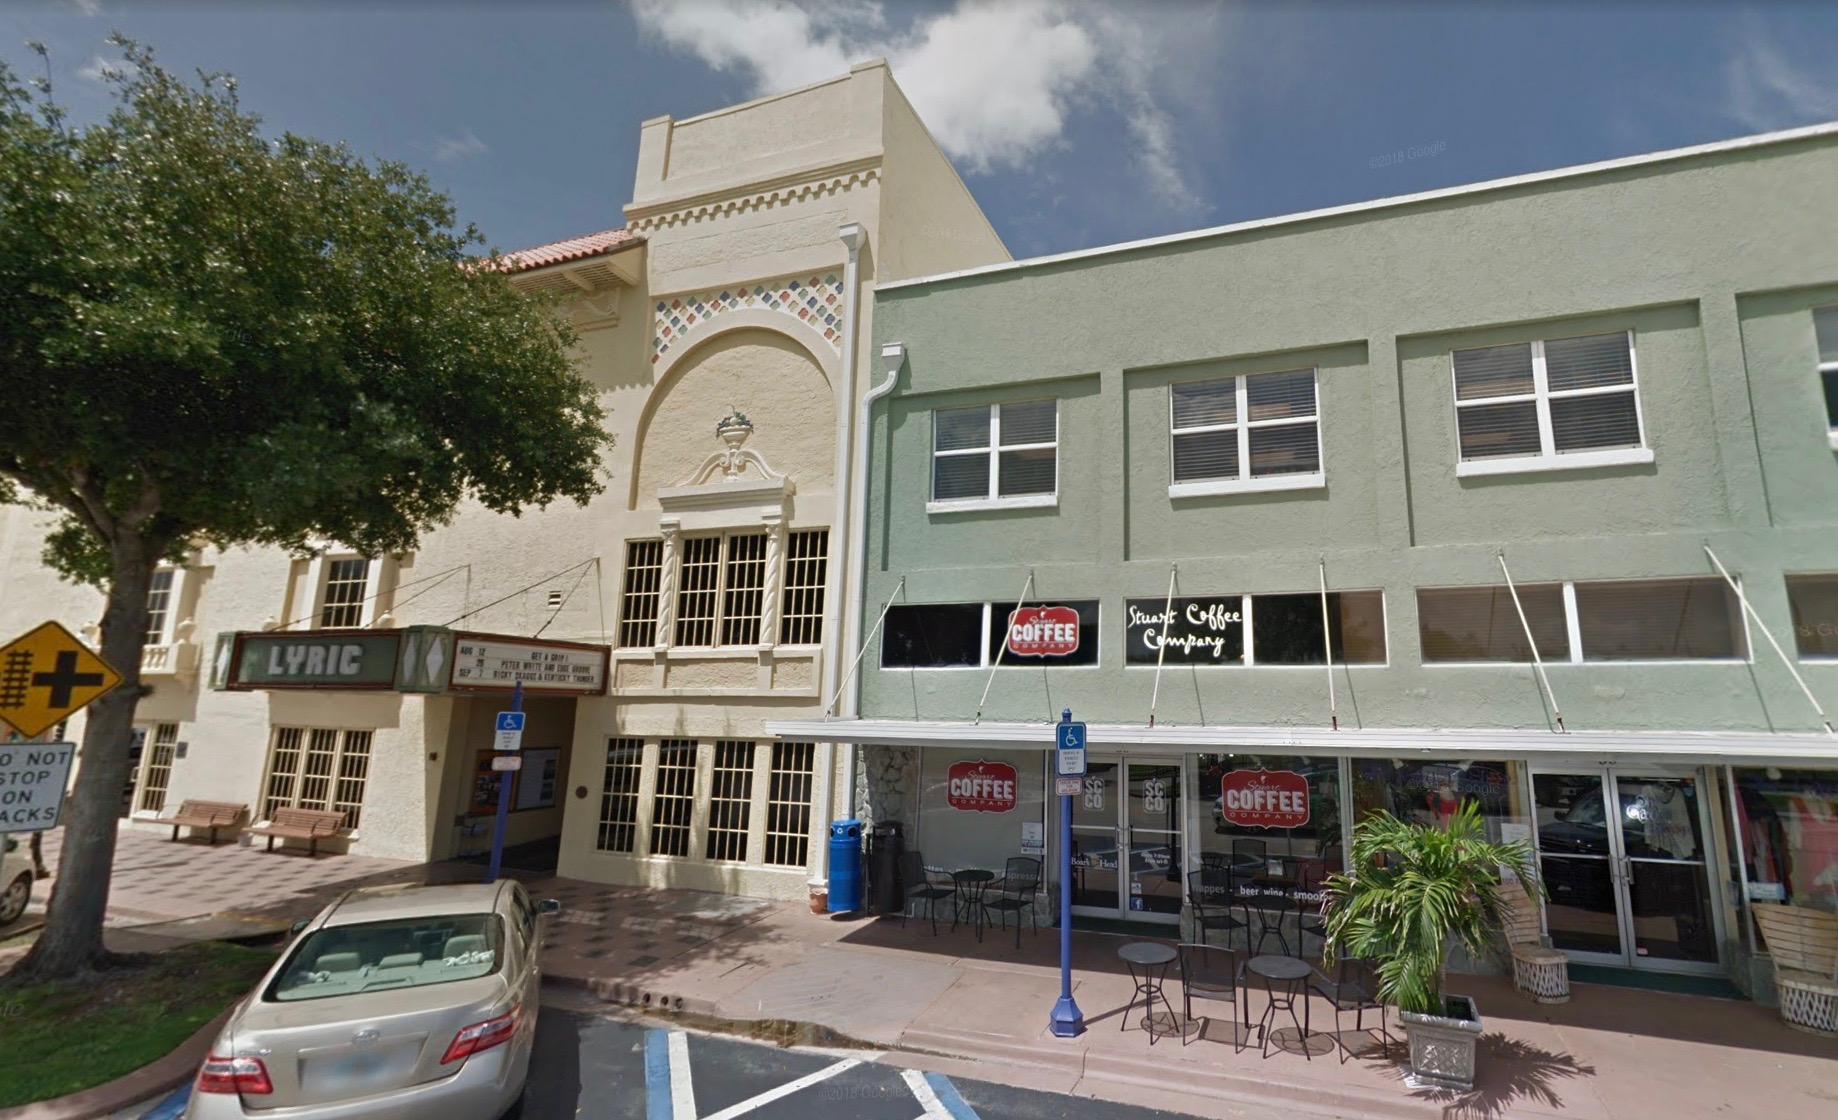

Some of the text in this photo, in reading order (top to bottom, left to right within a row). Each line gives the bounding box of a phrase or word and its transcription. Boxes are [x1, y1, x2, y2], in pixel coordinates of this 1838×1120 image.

[1128, 603, 1242, 630] Stuart Coffee
[1012, 623, 1076, 643] COFFEE
[1143, 628, 1225, 658] Company
[460, 646, 474, 656] AUG
[267, 644, 363, 675] LYRIC
[459, 668, 471, 677] SEP
[26, 751, 68, 766] NOT
[951, 778, 1015, 800] COFFEE
[1085, 780, 1102, 794] SC
[1145, 781, 1164, 797] SC
[2, 790, 33, 805] ON
[951, 799, 1012, 807] COMPANY
[1084, 794, 1102, 809] CO
[1145, 796, 1164, 811] CO
[1227, 789, 1306, 813] COFFEE
[1229, 812, 1304, 820] COMPANY
[1100, 860, 1118, 869] Head
[1240, 885, 1259, 896] beer
[1263, 887, 1283, 896] wine
